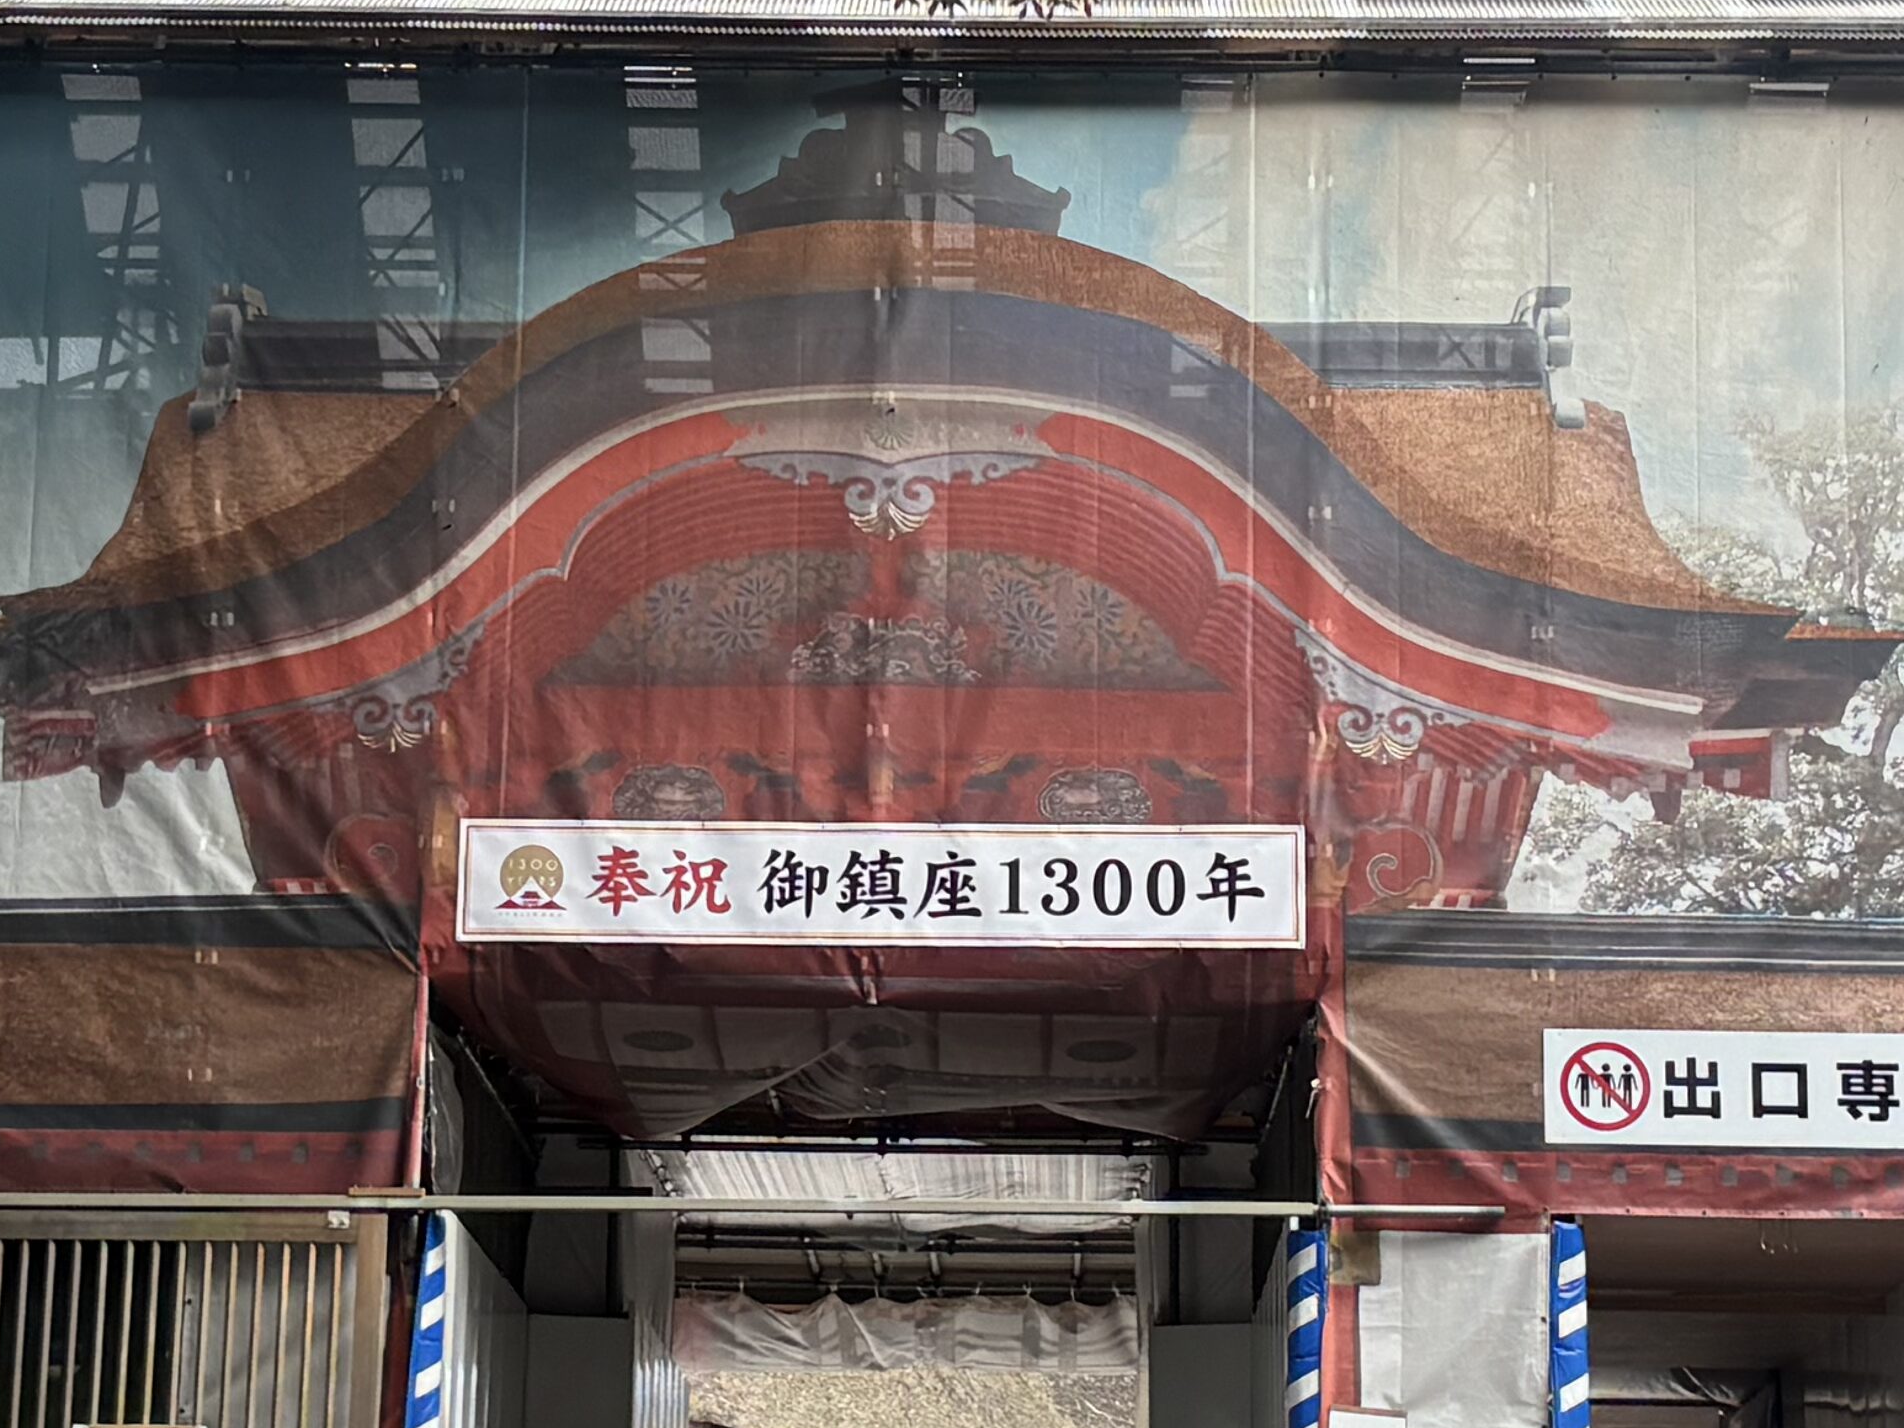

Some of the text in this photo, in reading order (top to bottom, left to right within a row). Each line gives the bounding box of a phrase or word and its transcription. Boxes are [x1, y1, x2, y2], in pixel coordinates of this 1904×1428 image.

[586, 847, 1266, 922] 奉祝 御鎮座1300年
